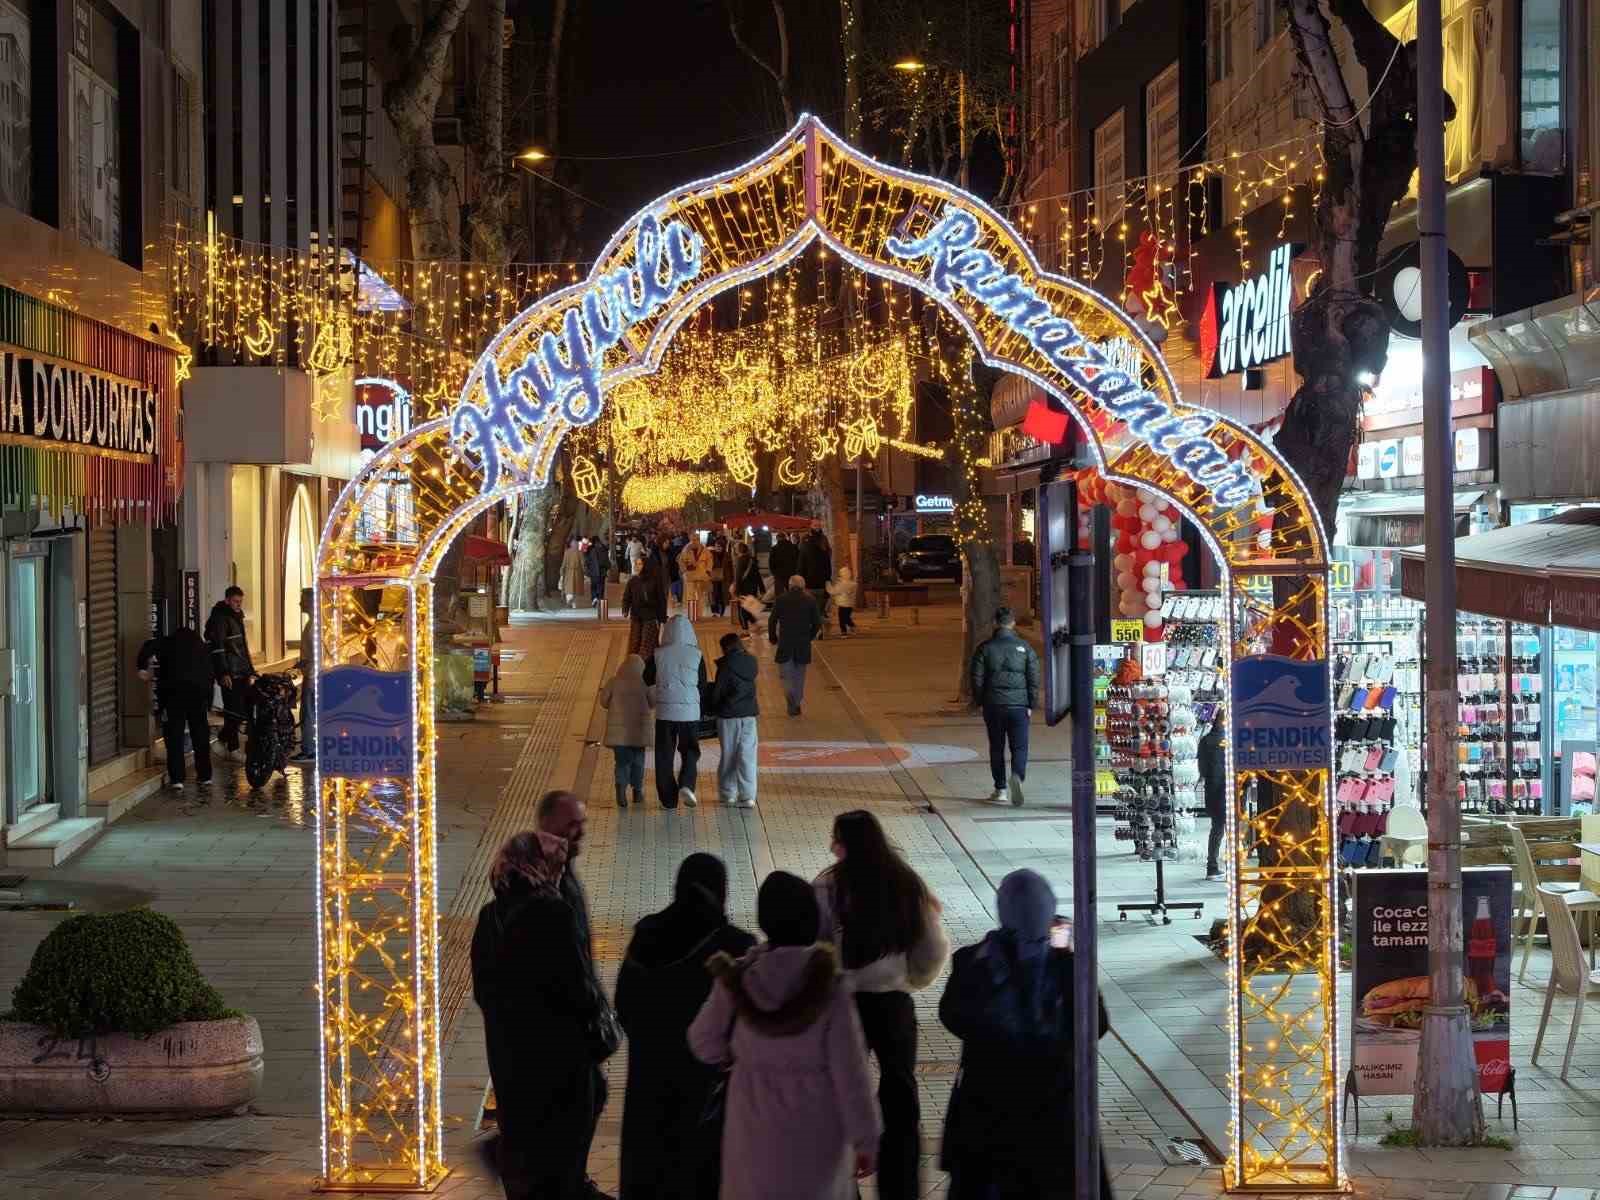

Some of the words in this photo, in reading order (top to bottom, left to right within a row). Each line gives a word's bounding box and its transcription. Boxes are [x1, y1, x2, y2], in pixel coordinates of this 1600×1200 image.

[1220, 243, 1292, 389] arçelik
[886, 203, 1258, 508] Ramazanlar
[1116, 629, 1140, 641] 550
[1373, 920, 1392, 932] ile
[1397, 919, 1428, 932] lezz
[1363, 1073, 1394, 1081] HASAN
